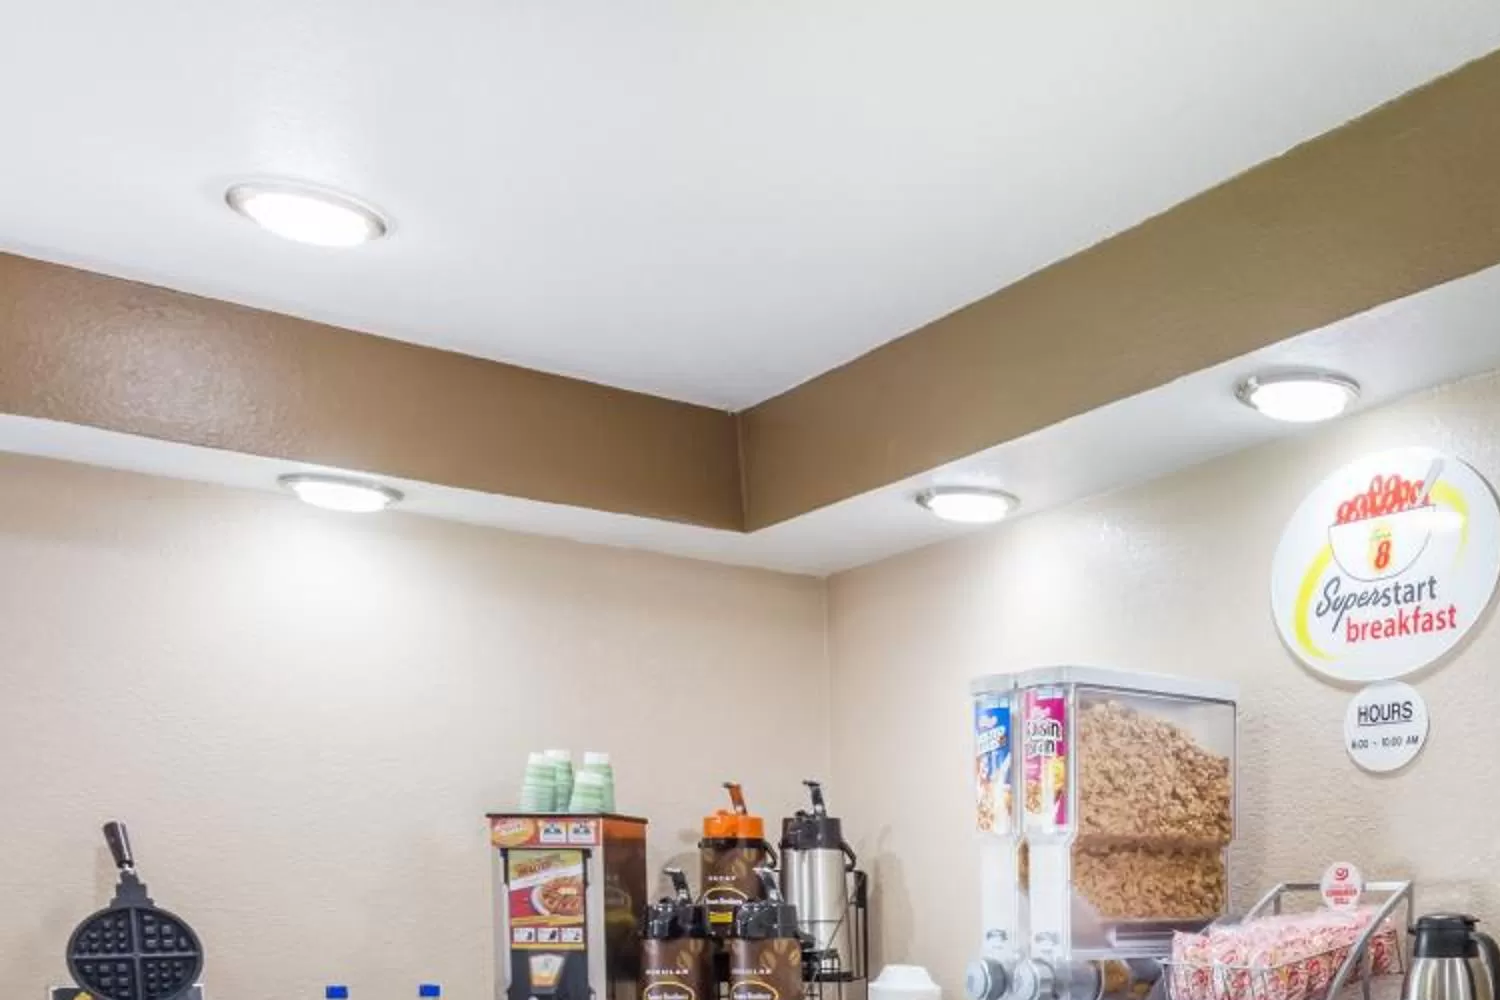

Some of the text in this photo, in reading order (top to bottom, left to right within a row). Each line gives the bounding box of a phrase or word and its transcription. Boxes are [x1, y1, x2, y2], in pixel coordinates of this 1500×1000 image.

[1315, 575, 1438, 634] Superstart
[1345, 603, 1457, 643] breakfast
[1357, 701, 1413, 723] HOURS
